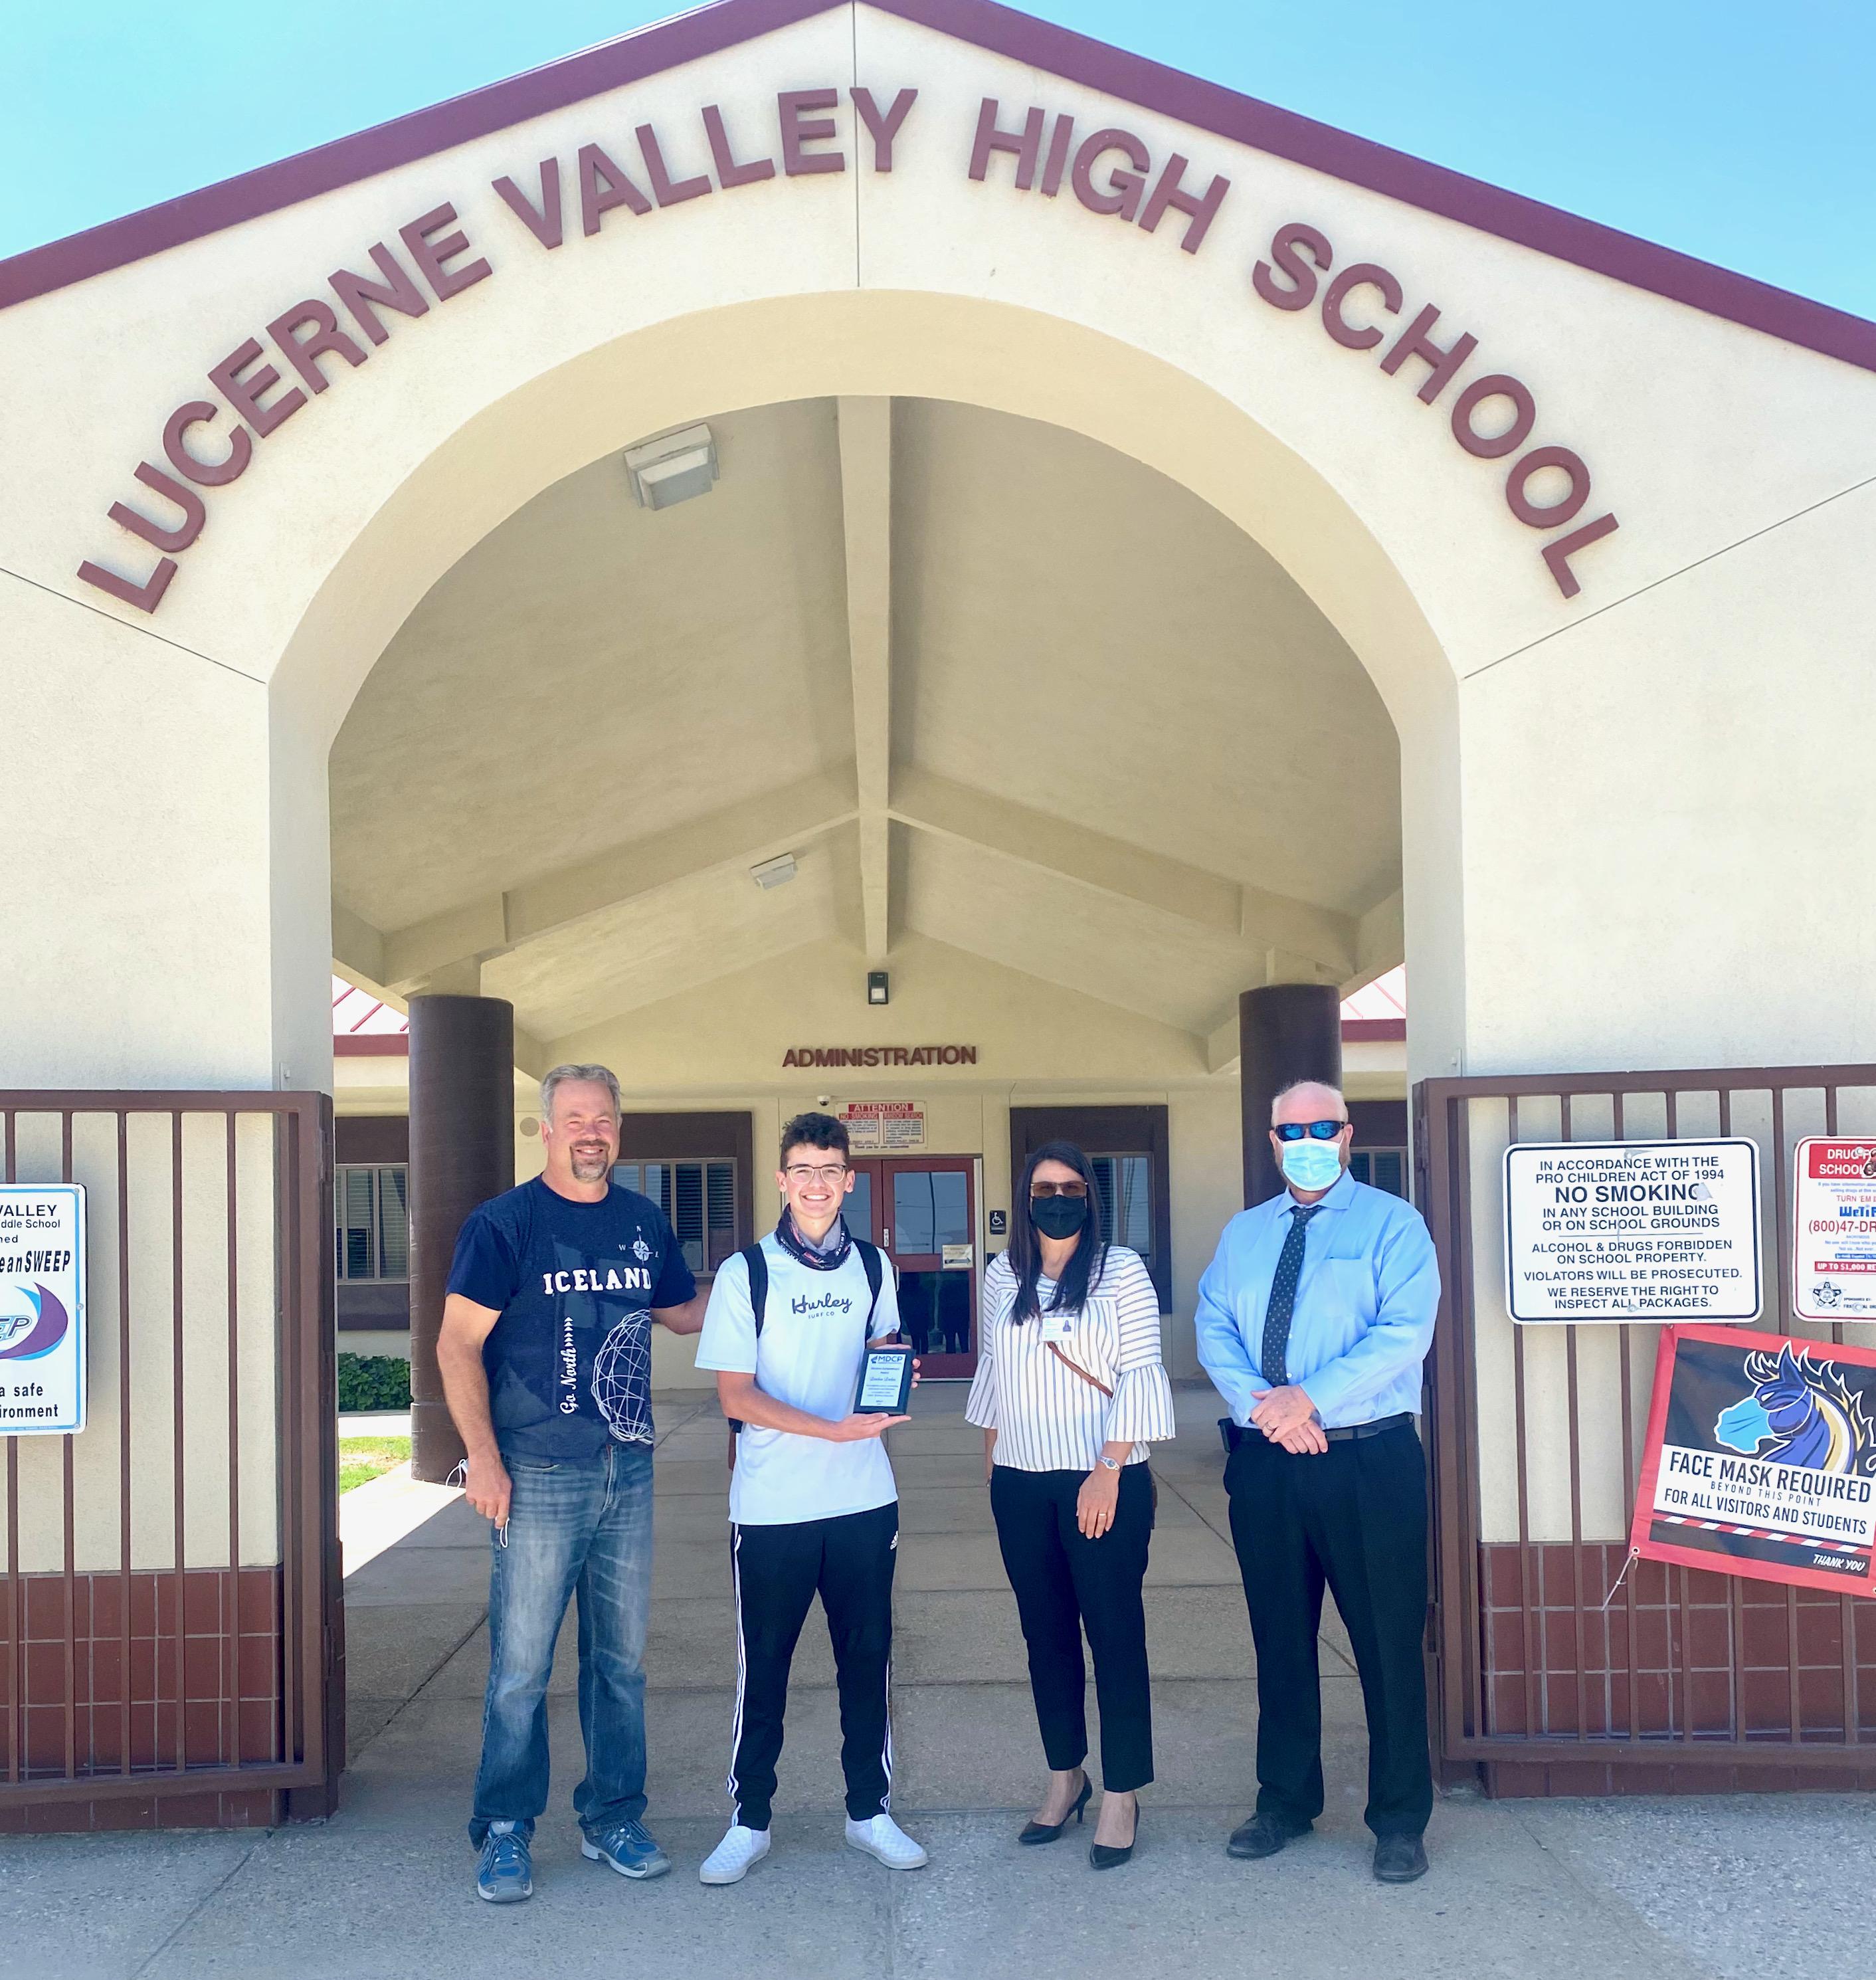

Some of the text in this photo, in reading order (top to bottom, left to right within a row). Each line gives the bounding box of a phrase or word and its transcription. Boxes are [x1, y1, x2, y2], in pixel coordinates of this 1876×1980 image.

[77, 87, 1619, 614] LUCERNE VALLEY HIGH SCHOOL
[782, 1046, 976, 1067] ADMINISTRATION
[854, 1103, 908, 1112] ATTENTION
[1540, 1156, 1719, 1171] IN ACCORDANCE WITH THE
[1536, 1169, 1724, 1183] PRO CHILDREN ACT OF 1994
[1555, 1186, 1588, 1203] NO
[1543, 1205, 1718, 1218] IN ANY SCHOOL BUILDING
[26, 1219, 60, 1229] School
[1543, 1217, 1720, 1231] OR ON SCHOOL GROUNDS
[1532, 1240, 1732, 1252] ALCOHOL & DRUGS FORBIDDEN
[1557, 1252, 1707, 1264] ON SCHOOL PROPERTY.
[543, 1267, 651, 1294] ICELAND
[1524, 1268, 1742, 1281] VIOLATORS WILL BE PROSECUTED.
[1547, 1285, 1719, 1297] WE RESERVE THE RIGHT TO
[792, 1292, 852, 1314] Hurley
[1554, 1299, 1608, 1308] INSPECT
[1640, 1298, 1712, 1308] PACKAGES.
[559, 1347, 577, 1414] Go North
[14, 1383, 44, 1397] safe
[1669, 1451, 1871, 1503] FACE MASK REQUIRED
[1711, 1481, 1821, 1506] BEYOND THIS POINT
[1665, 1488, 1867, 1534] FOR ALL VISITORS AND STUDENTS
[1813, 1554, 1865, 1571] THANK YOU
